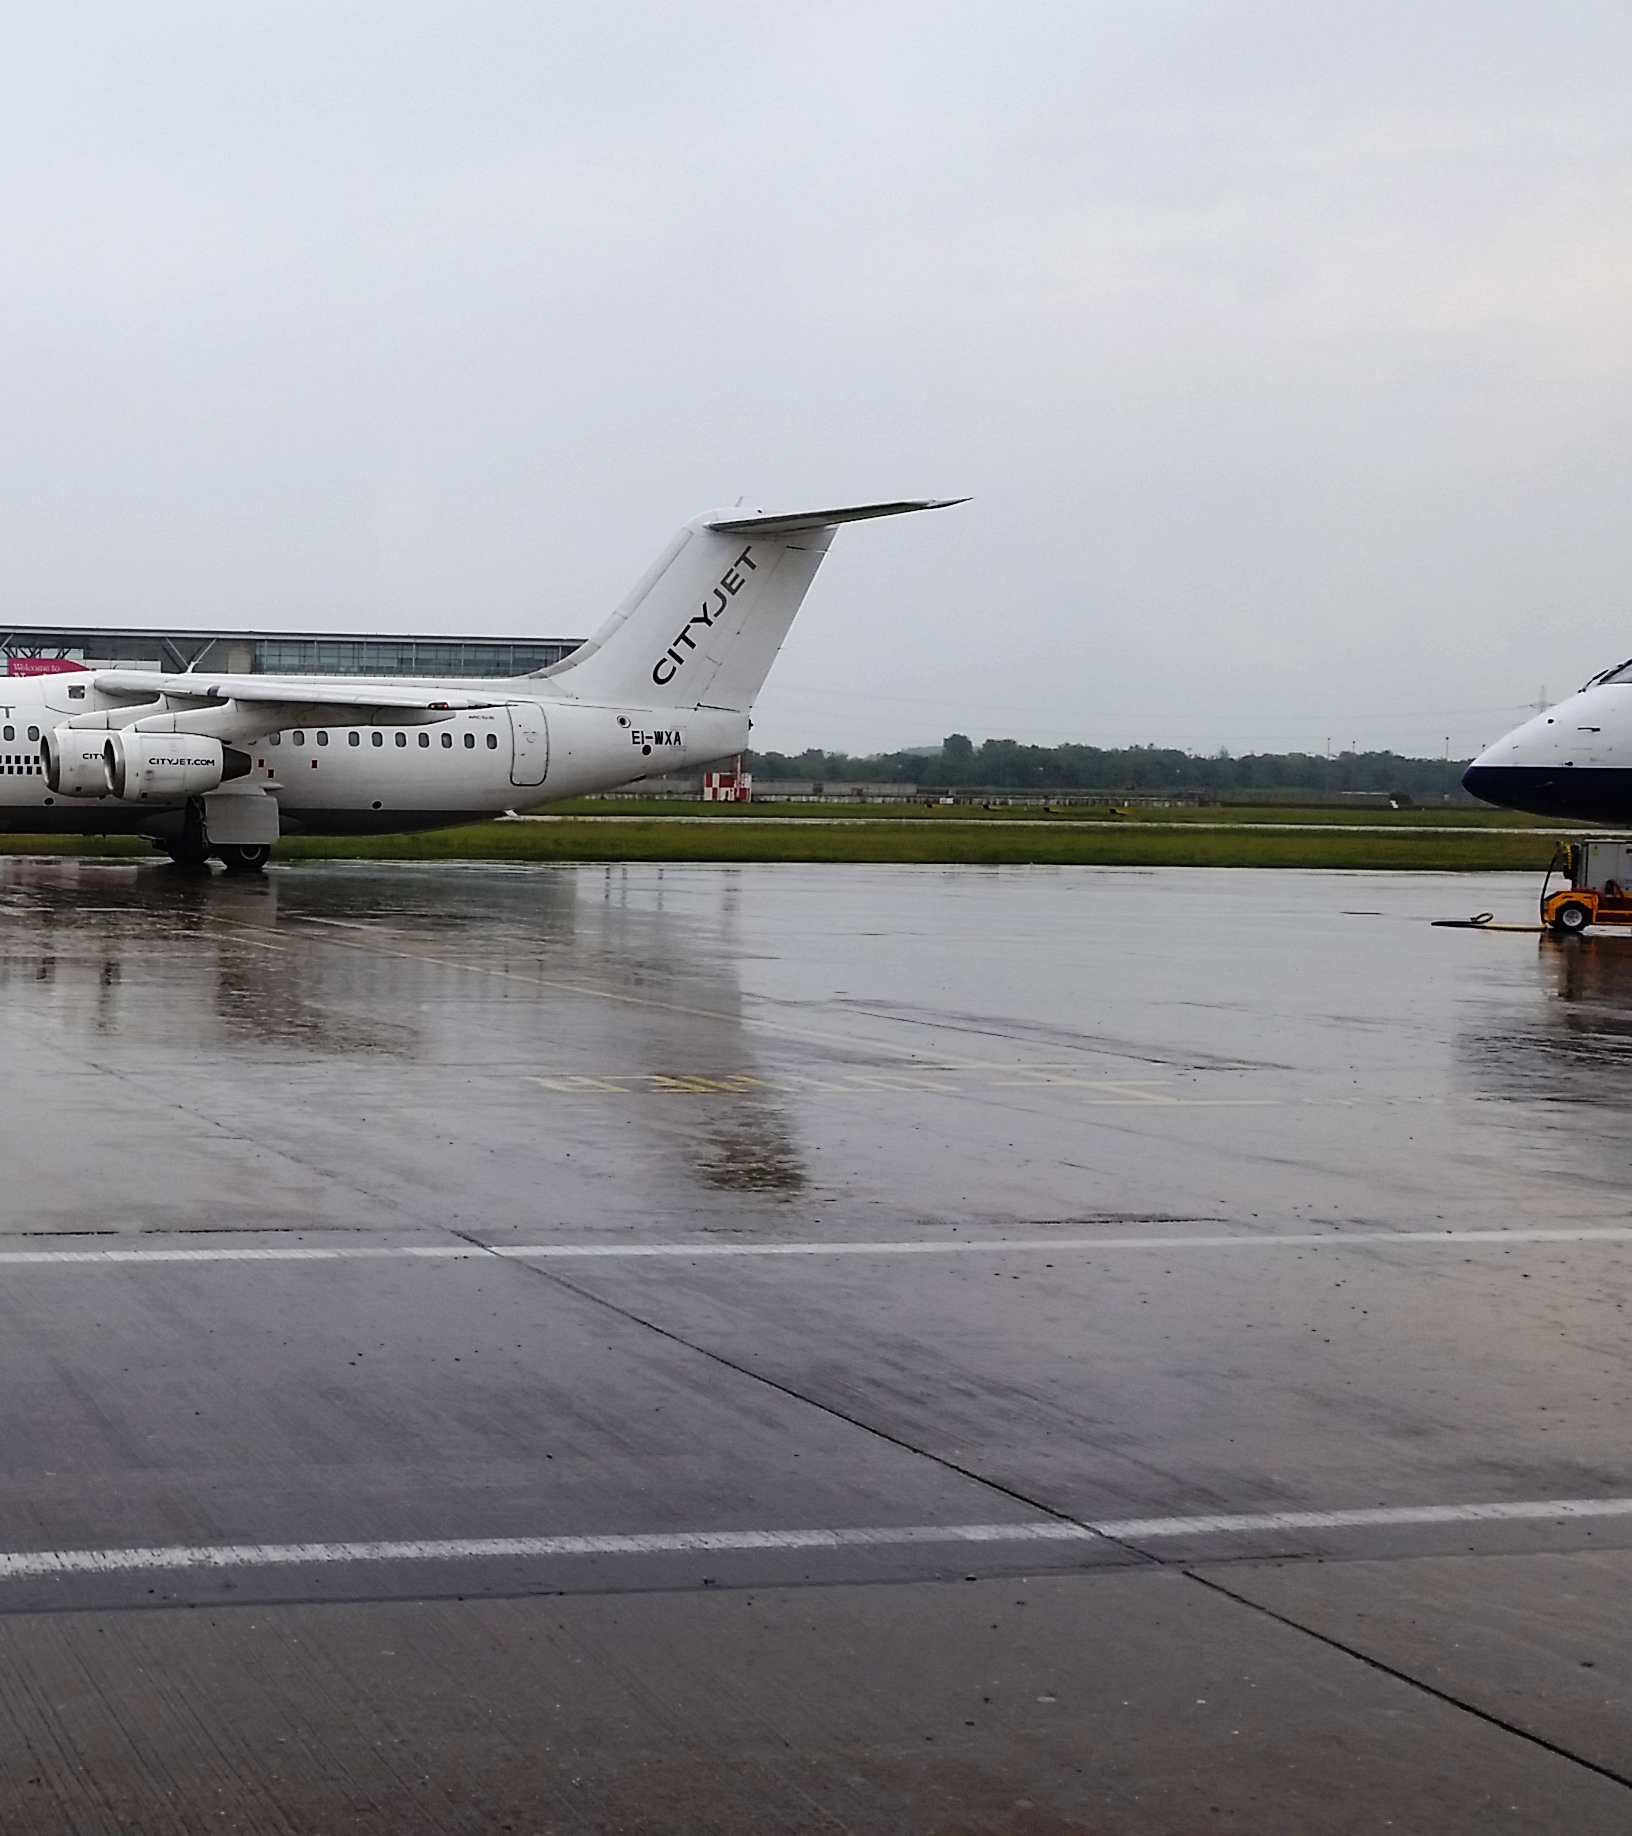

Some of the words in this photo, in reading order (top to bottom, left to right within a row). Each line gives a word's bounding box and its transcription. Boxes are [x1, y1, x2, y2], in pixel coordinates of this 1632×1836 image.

[652, 545, 758, 686] CITYJET
[13, 663, 50, 672] Welcome
[51, 663, 61, 672] to
[631, 730, 682, 746] EI-WXA
[148, 757, 215, 766] CITYJET.COM
